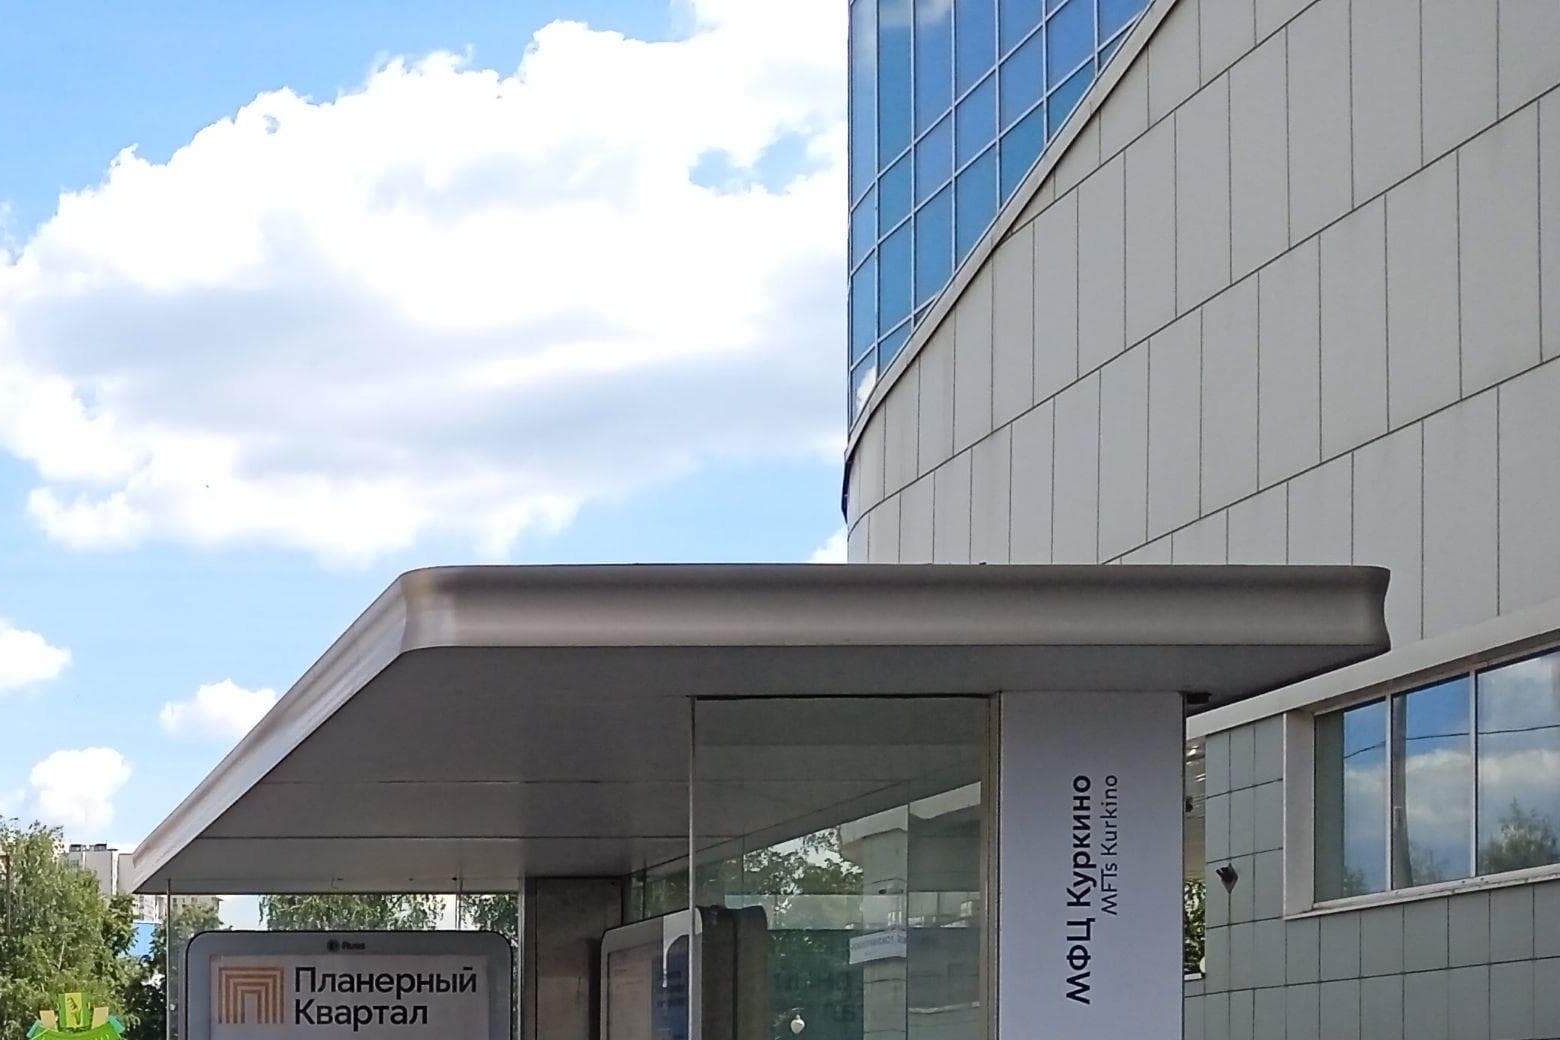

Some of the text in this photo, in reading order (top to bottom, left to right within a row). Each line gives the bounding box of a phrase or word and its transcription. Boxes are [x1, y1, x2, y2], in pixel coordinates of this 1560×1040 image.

[1099, 774, 1118, 915] MFTs Kurkino
[1066, 775, 1097, 1005] МФЦ Куркино
[295, 966, 477, 1000] Планерный
[295, 998, 428, 1032] Квартал
